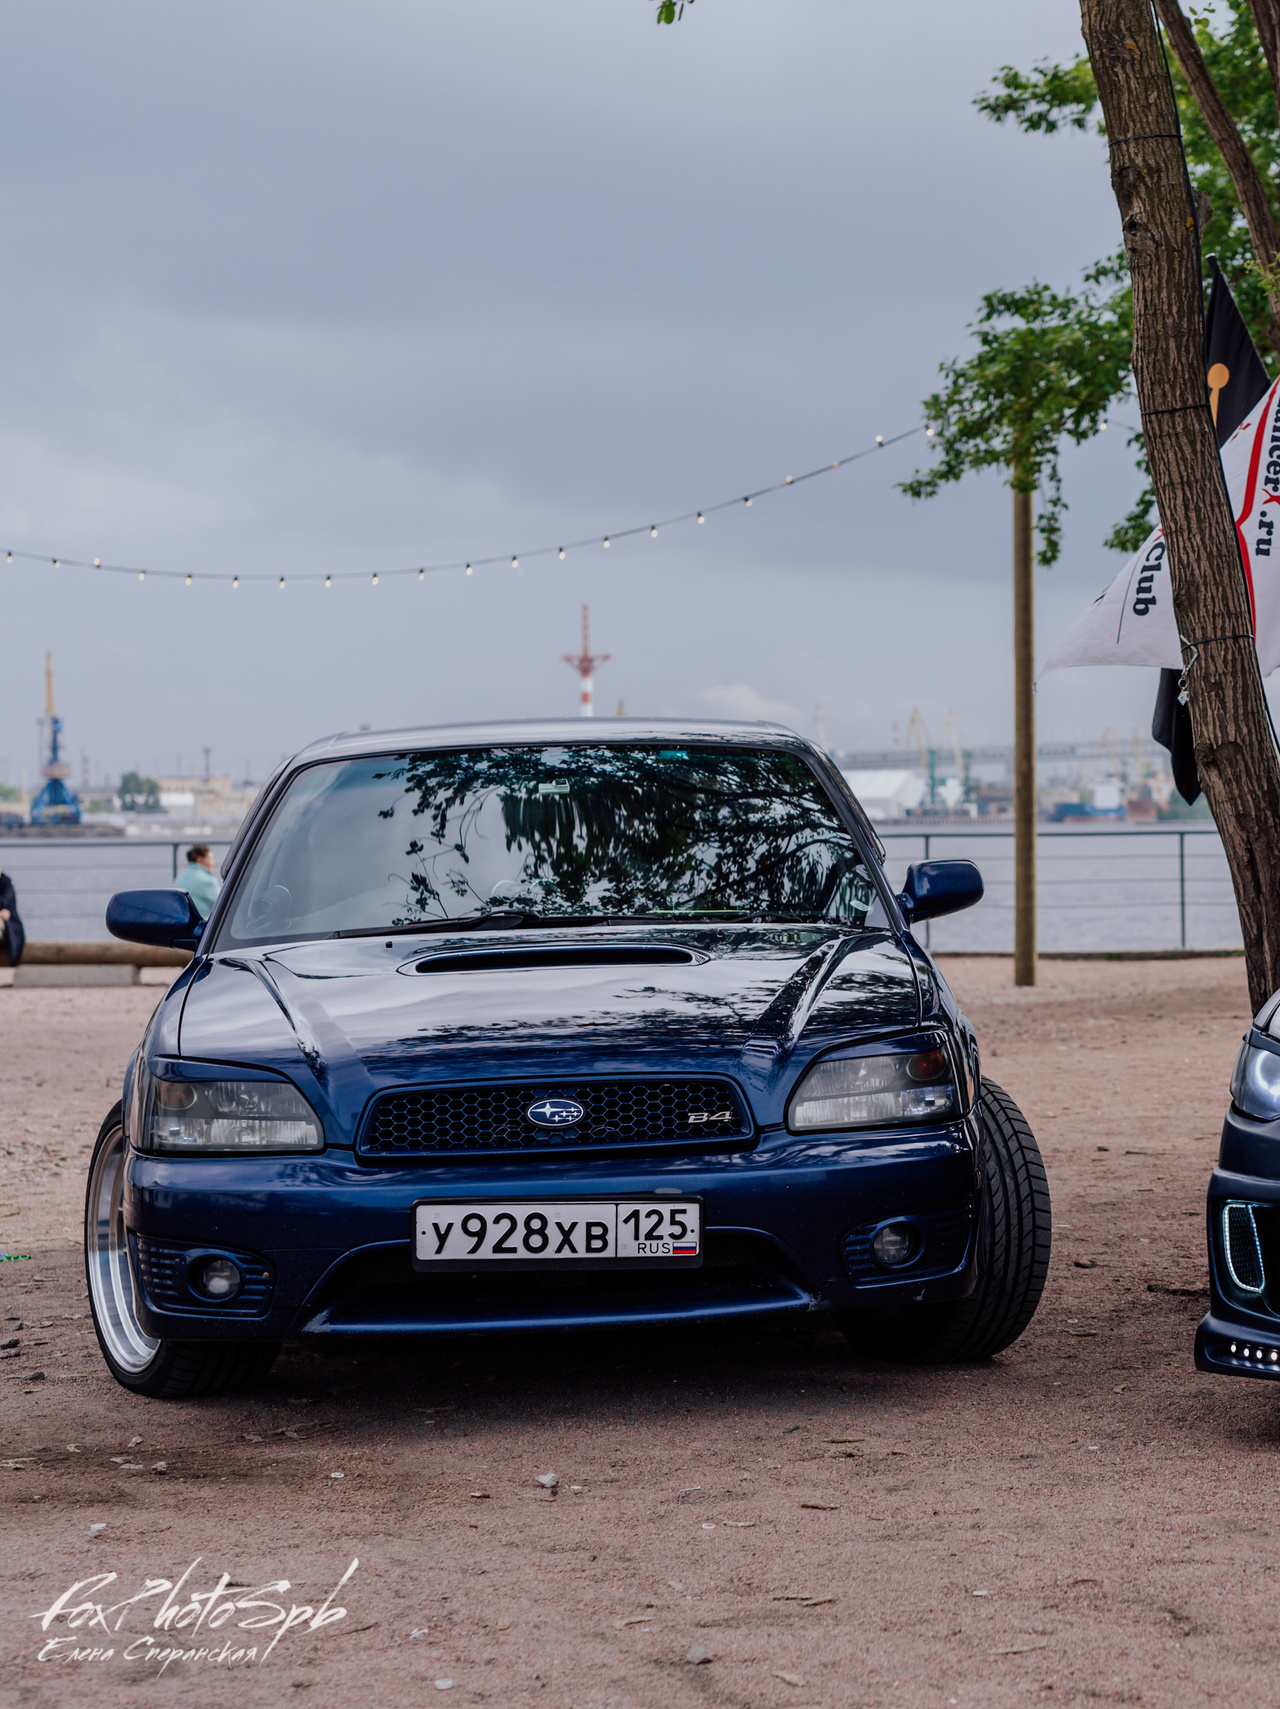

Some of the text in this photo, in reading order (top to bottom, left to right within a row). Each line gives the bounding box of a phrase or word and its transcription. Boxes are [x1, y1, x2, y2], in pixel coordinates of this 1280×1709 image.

[687, 1110, 732, 1124] B4
[622, 1208, 688, 1242] 125
[637, 1242, 671, 1255] RUS
